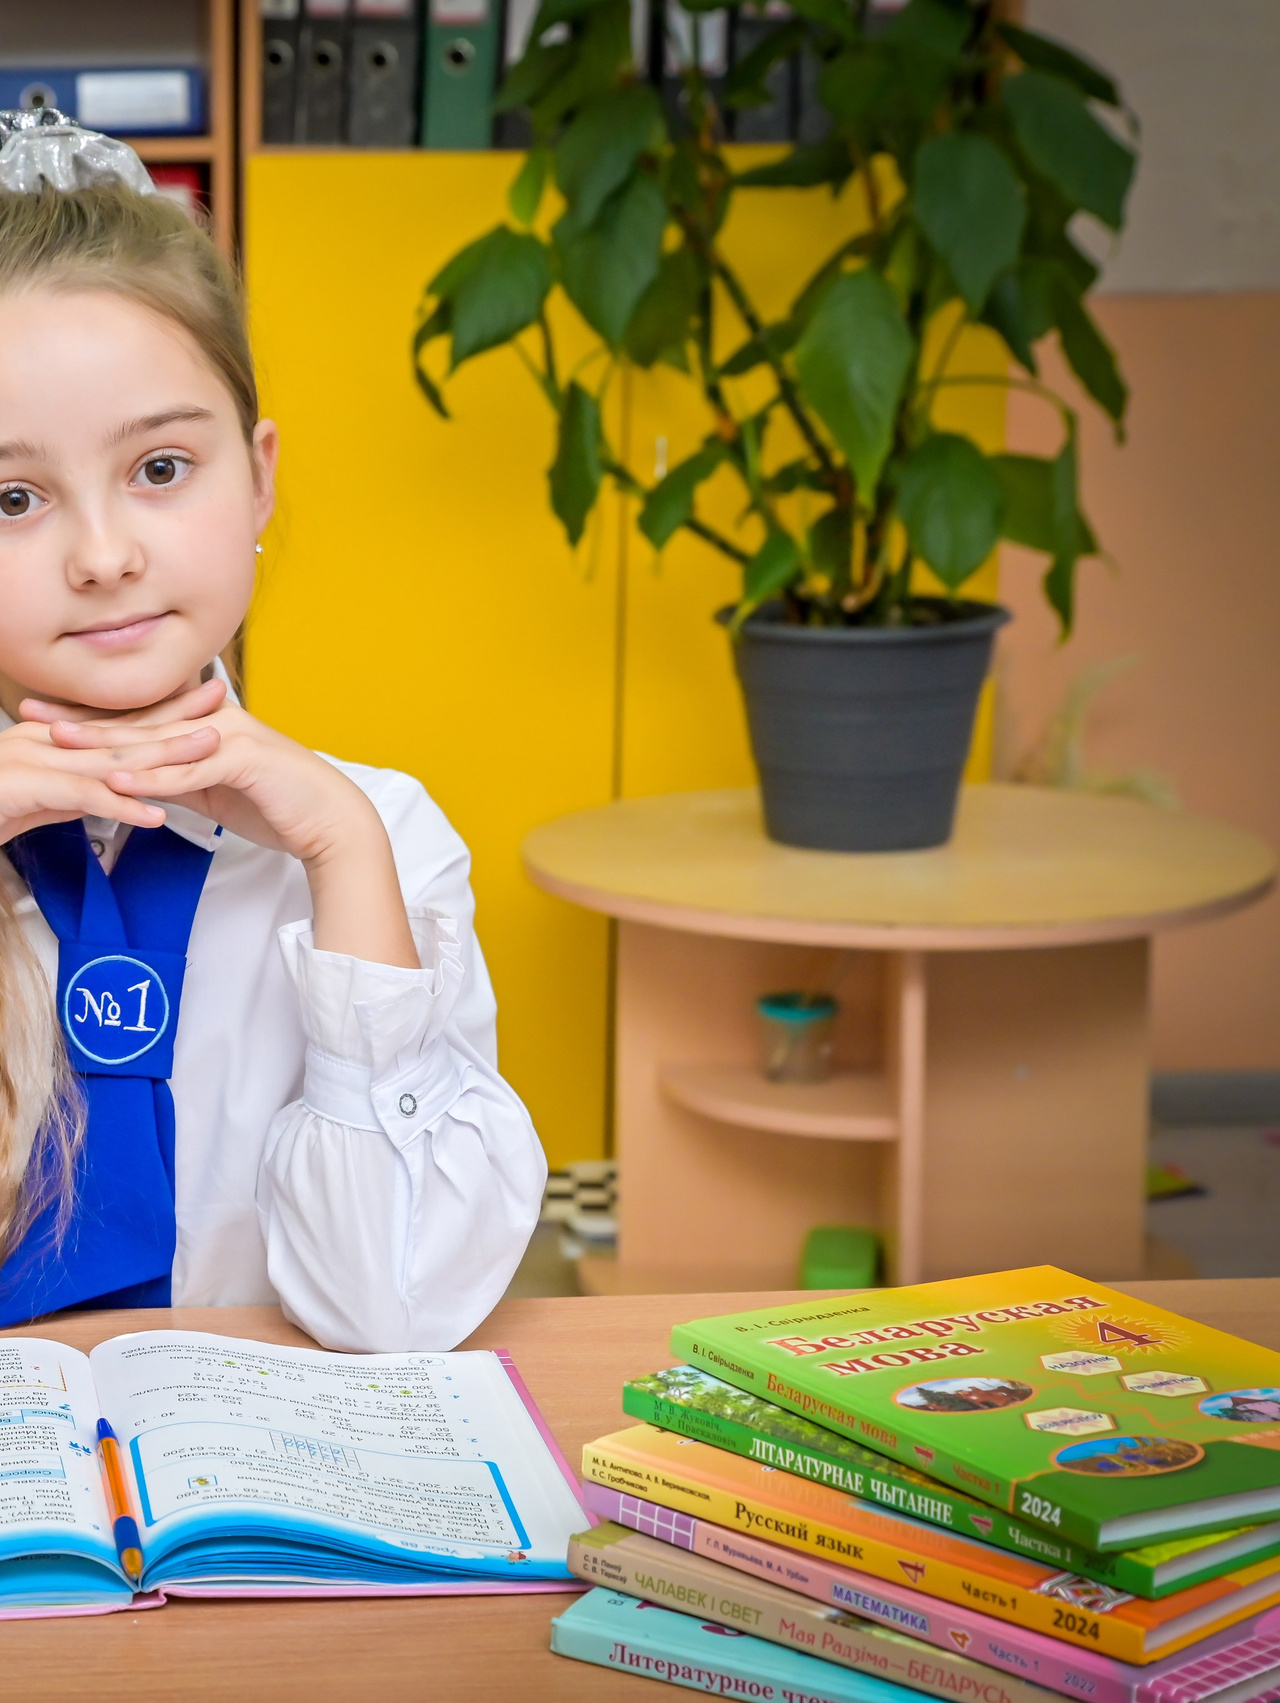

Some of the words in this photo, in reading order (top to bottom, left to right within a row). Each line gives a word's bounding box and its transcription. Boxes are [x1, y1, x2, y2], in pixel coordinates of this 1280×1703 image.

[768, 1305, 871, 1328] Свірыдзенка
[768, 1295, 1108, 1357] Беларуская
[1098, 1321, 1162, 1347] 4
[186, 1349, 254, 1362] одинаковых
[272, 1363, 304, 1371] сшить
[692, 1343, 703, 1355] В.
[708, 1350, 756, 1380] Свірыдзенка
[308, 1368, 344, 1377] можно
[32, 1411, 68, 1419] Минск
[290, 1399, 342, 1414] Выполни
[653, 1399, 666, 1412] М.
[668, 1404, 678, 1417] В.
[399, 1434, 454, 1442] Вычисли
[677, 1417, 737, 1449] Праскаловіч
[766, 1371, 856, 1429] Беларуская
[859, 1417, 898, 1449] мова
[952, 1462, 993, 1492] Частка
[993, 1480, 1001, 1494] 1
[1020, 1491, 1063, 1528] 2024
[294, 1501, 349, 1518] Дополни
[749, 1437, 865, 1494] ЛІТАРАТУРНАЕ
[869, 1475, 954, 1526] ЧЫТАННЕ
[1008, 1526, 1062, 1559] Частка
[1083, 1554, 1118, 1578] 2024
[424, 1545, 460, 1556] Урок
[442, 1533, 512, 1546] Рассмотри
[735, 1501, 808, 1542] Русский
[815, 1533, 864, 1560] язык
[961, 1580, 1008, 1608] Часть
[1010, 1597, 1017, 1610] 1
[1052, 1608, 1101, 1642] 2024
[634, 1571, 708, 1609] ЧАЛАВЕК
[719, 1599, 764, 1626] СВЕТ
[778, 1617, 816, 1646] Мая
[832, 1583, 930, 1634] МАТЕМАТИКА
[951, 1631, 970, 1649] 4
[988, 1642, 1029, 1669] Часть
[1033, 1659, 1040, 1672] 1
[1063, 1671, 1096, 1693] 2022
[609, 1642, 774, 1700] Литературное
